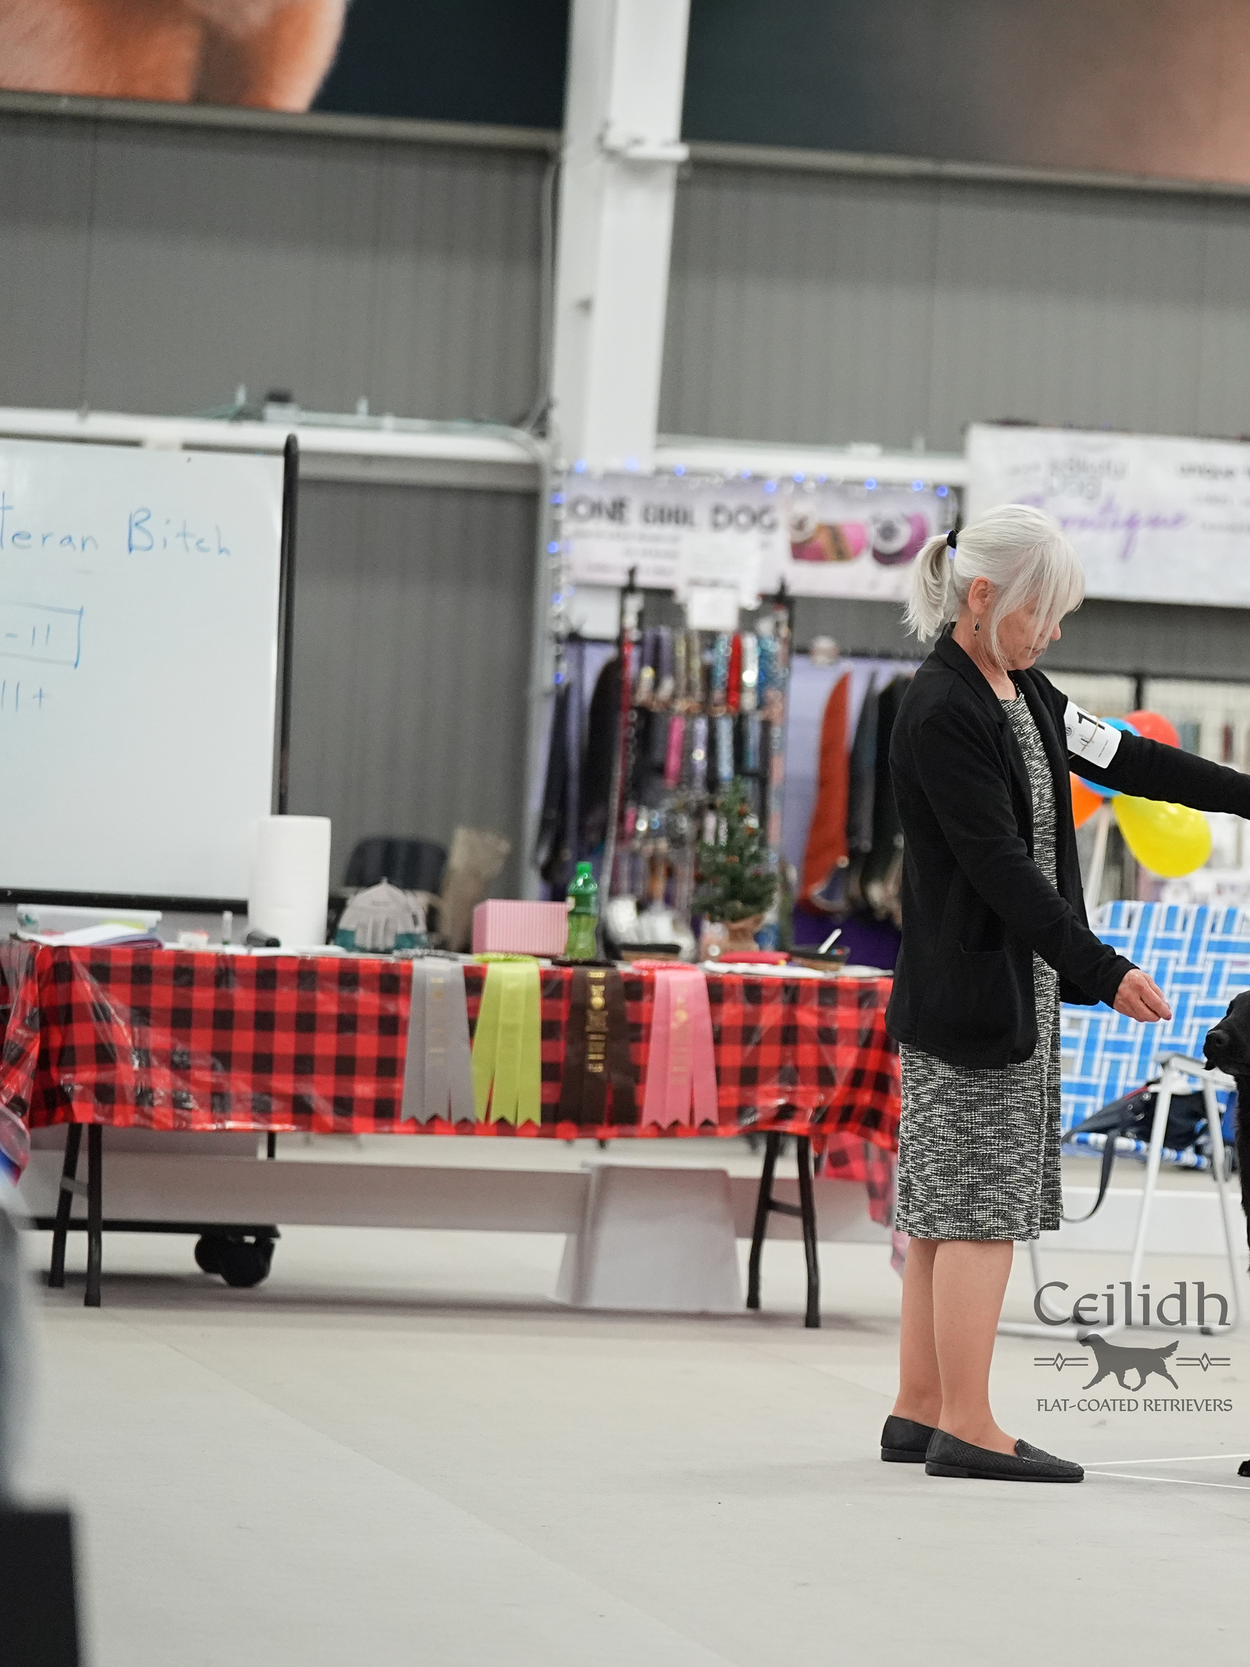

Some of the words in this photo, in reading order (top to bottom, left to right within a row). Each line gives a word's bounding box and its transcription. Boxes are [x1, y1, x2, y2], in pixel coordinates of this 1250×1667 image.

[126, 506, 231, 556] Bitch
[566, 495, 628, 526] ONE
[710, 503, 780, 533] DOG
